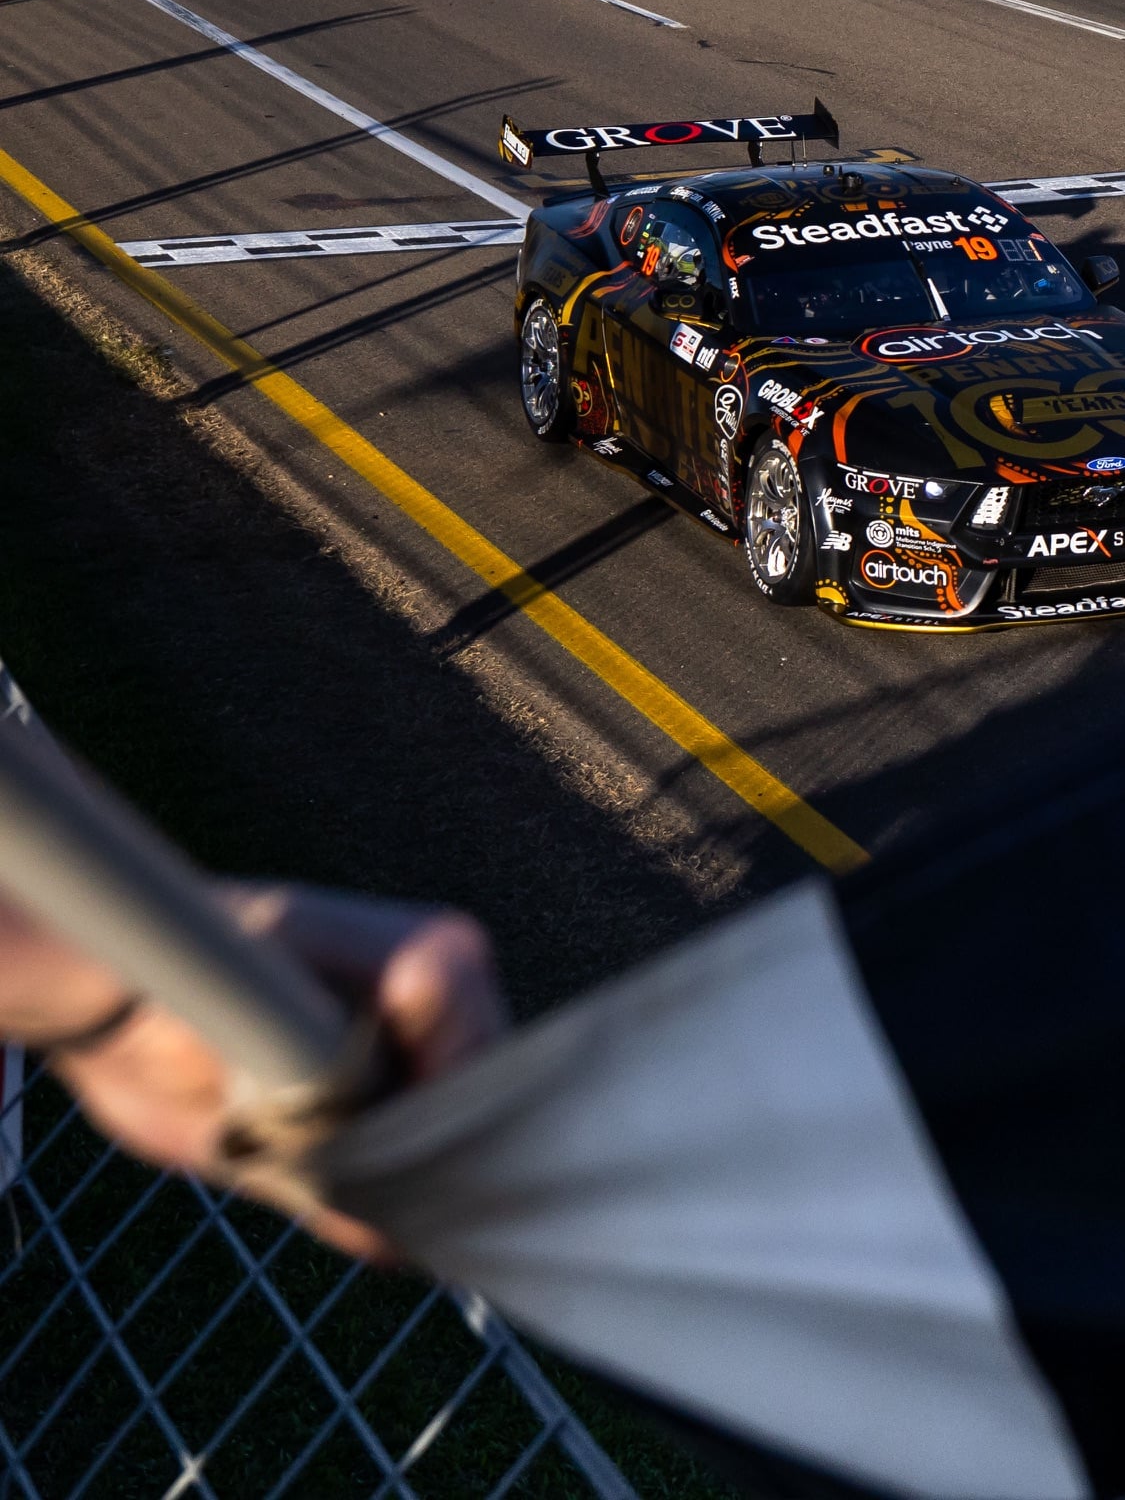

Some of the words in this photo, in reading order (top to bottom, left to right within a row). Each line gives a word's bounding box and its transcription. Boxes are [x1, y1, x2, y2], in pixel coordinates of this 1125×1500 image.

[702, 200, 726, 223] PAYNE
[752, 211, 970, 250] Steadfast
[641, 244, 661, 277] 19
[954, 236, 998, 261] 19
[878, 323, 1103, 357] airtouch
[696, 346, 719, 369] nti
[758, 379, 825, 430] GROBLOX
[1094, 457, 1123, 471] Ford
[845, 472, 916, 499] GROVE
[895, 526, 920, 538] mits
[895, 536, 926, 546] Melbourne
[926, 540, 957, 550] Indigenous
[1027, 526, 1112, 558] APEX
[865, 560, 947, 587] airtouch
[846, 611, 894, 624] APEX
